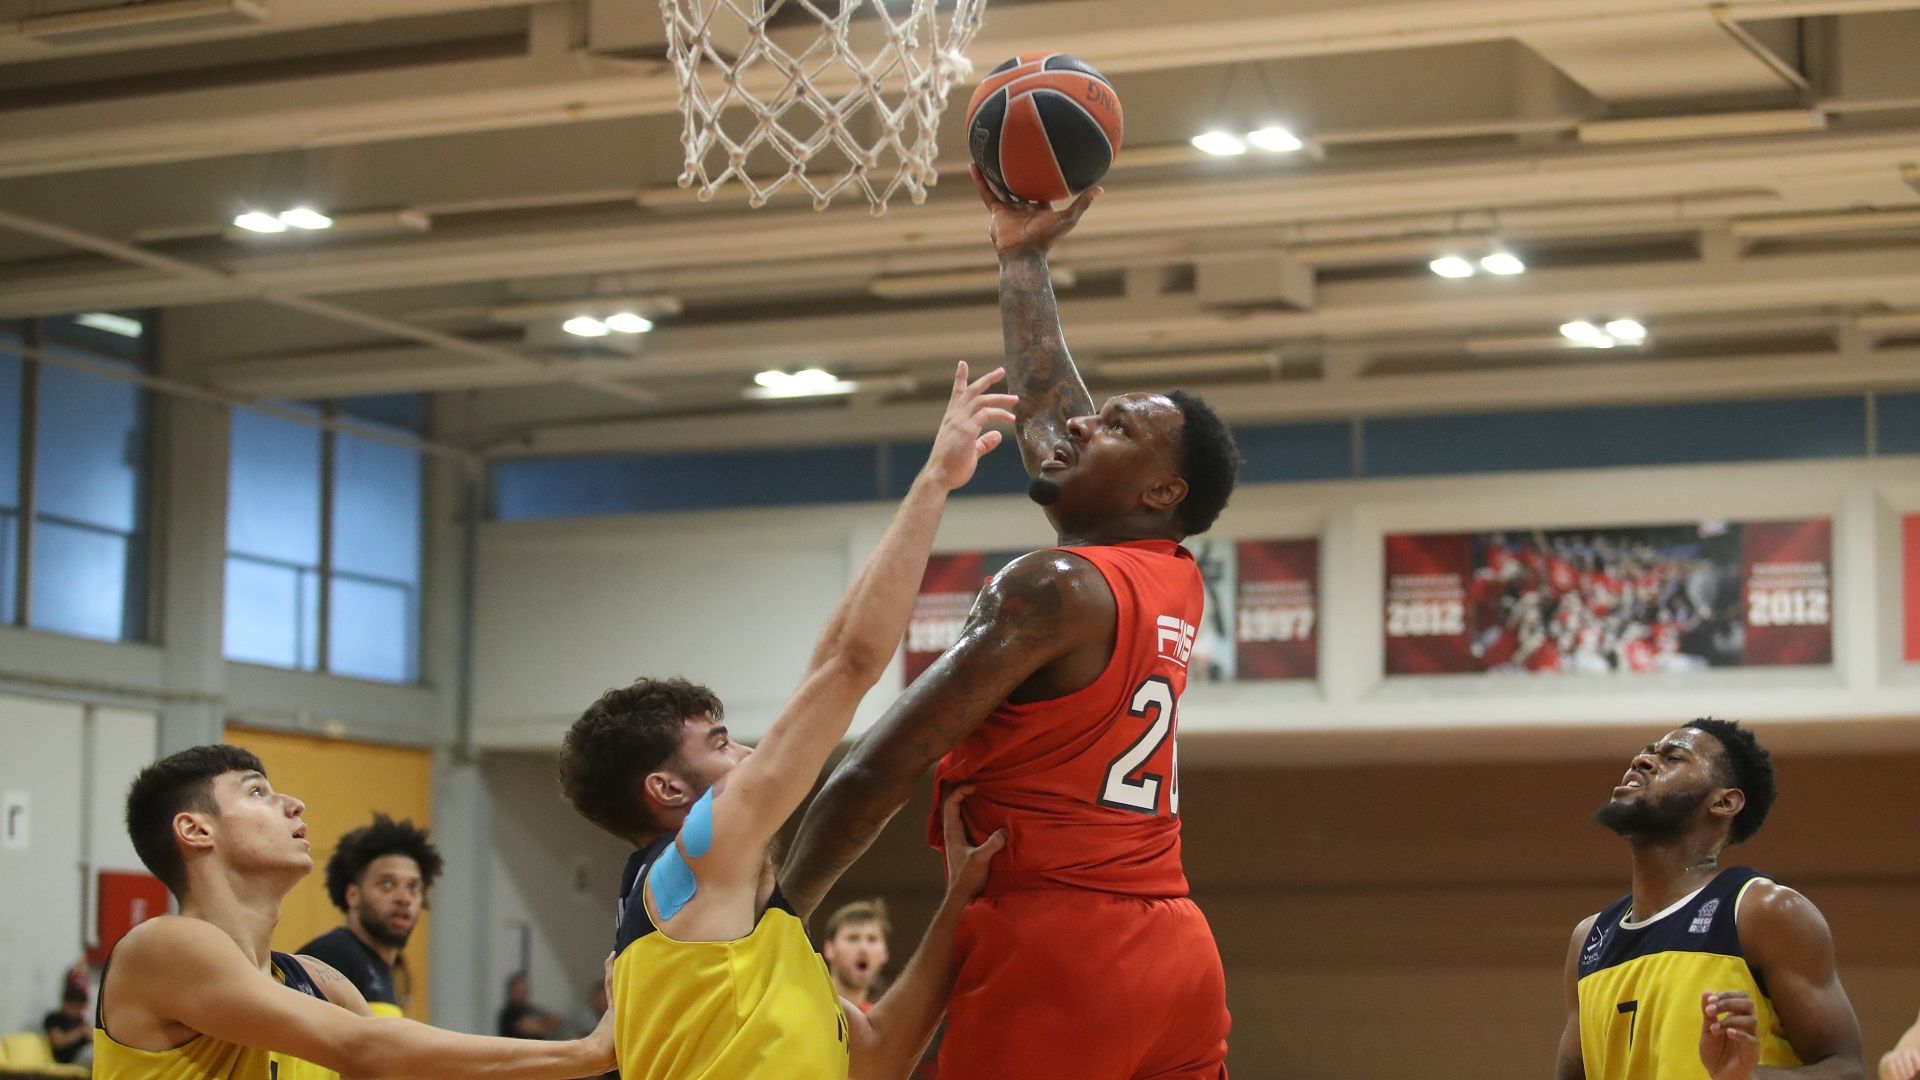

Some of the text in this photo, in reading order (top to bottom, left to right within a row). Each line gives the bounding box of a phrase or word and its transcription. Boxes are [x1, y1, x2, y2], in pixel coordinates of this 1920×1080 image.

[1389, 601, 1465, 636] 2012
[1748, 591, 1828, 626] 2012
[1097, 675, 1179, 819] 2
[1617, 1000, 1638, 1050] 7
